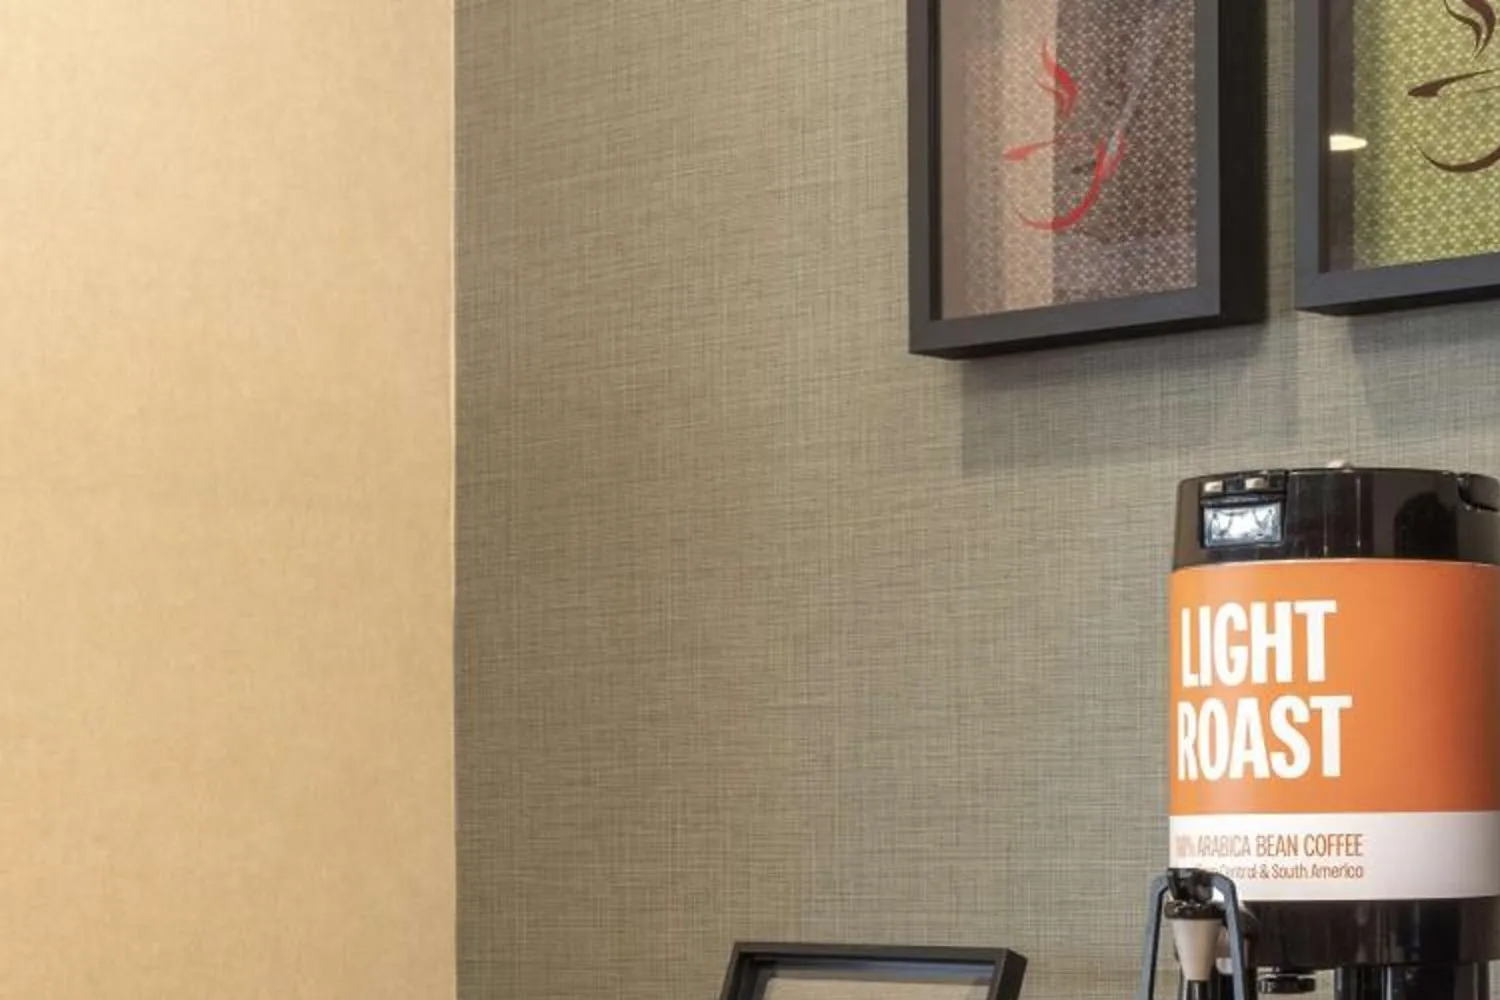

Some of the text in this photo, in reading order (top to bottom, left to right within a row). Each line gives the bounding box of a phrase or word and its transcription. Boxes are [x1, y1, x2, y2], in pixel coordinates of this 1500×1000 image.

[1181, 600, 1337, 687] LIGHT
[1177, 695, 1352, 781] ROAST
[1198, 834, 1250, 857] ARABICA
[1256, 834, 1299, 857] BEAN
[1303, 833, 1364, 857] COFFEE
[1272, 863, 1308, 879] South
[1312, 864, 1364, 879] America
